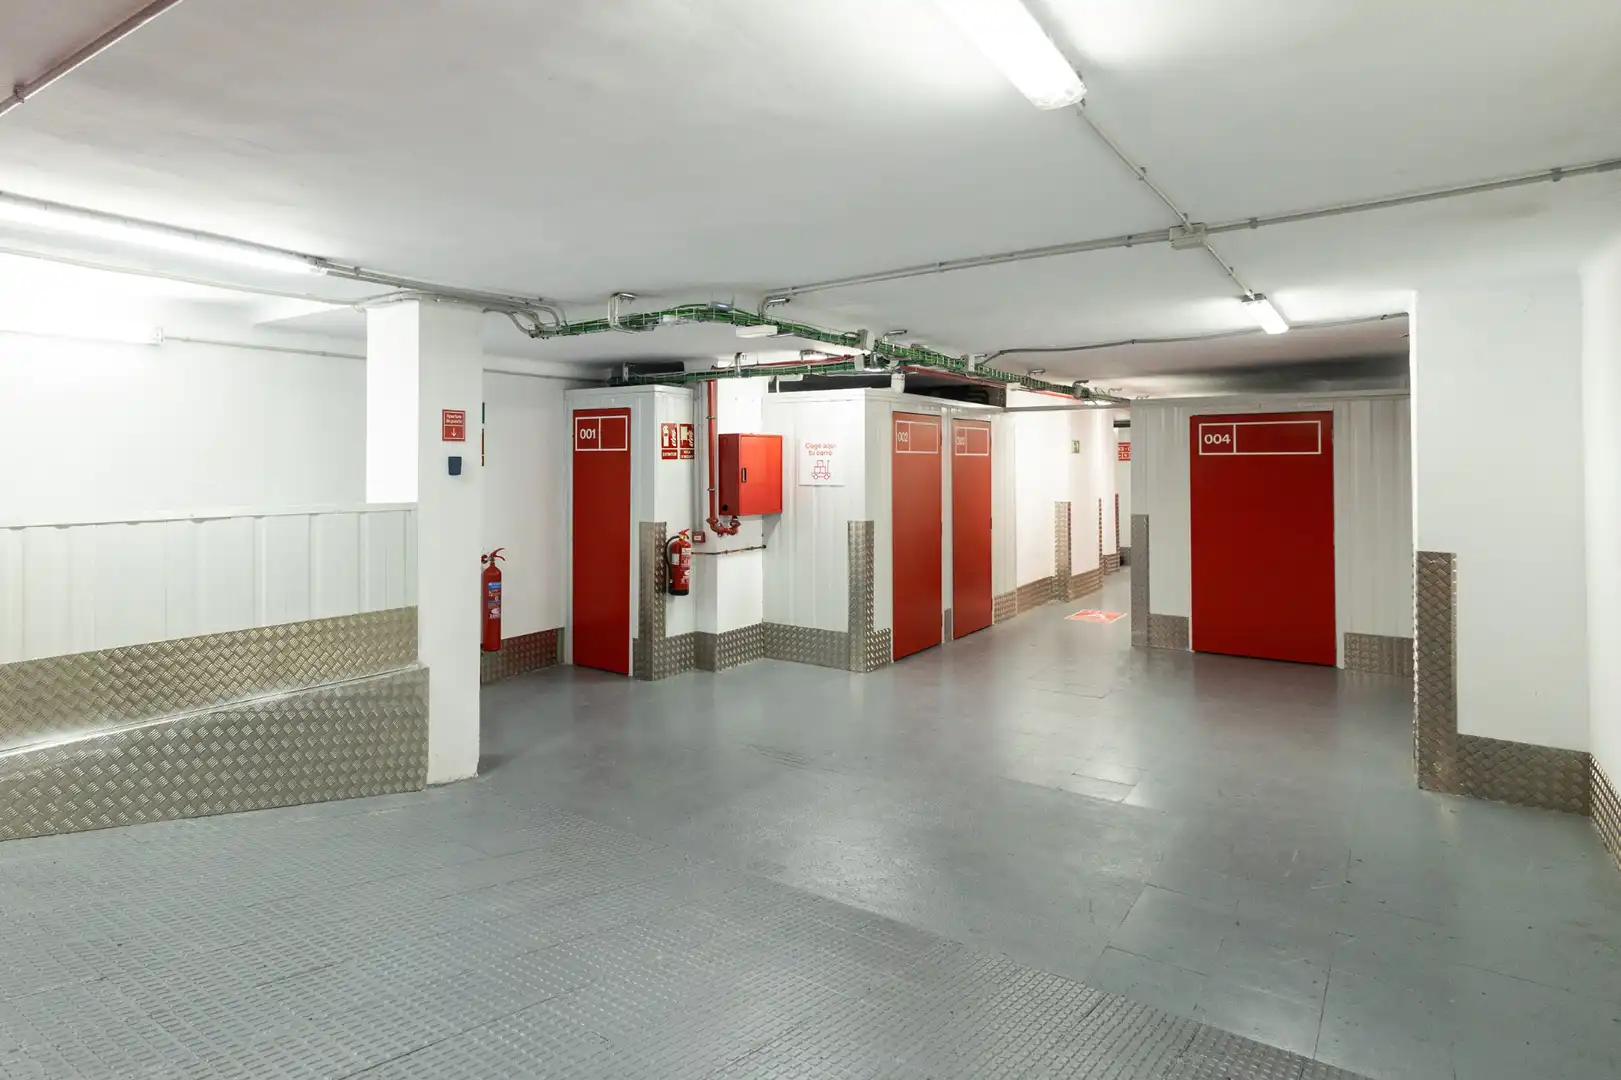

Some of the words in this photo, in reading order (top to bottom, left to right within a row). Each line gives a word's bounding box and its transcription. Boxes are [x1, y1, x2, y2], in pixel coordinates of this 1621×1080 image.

[580, 428, 596, 439] 001
[1204, 434, 1231, 444] 004
[805, 442, 821, 450] Coge
